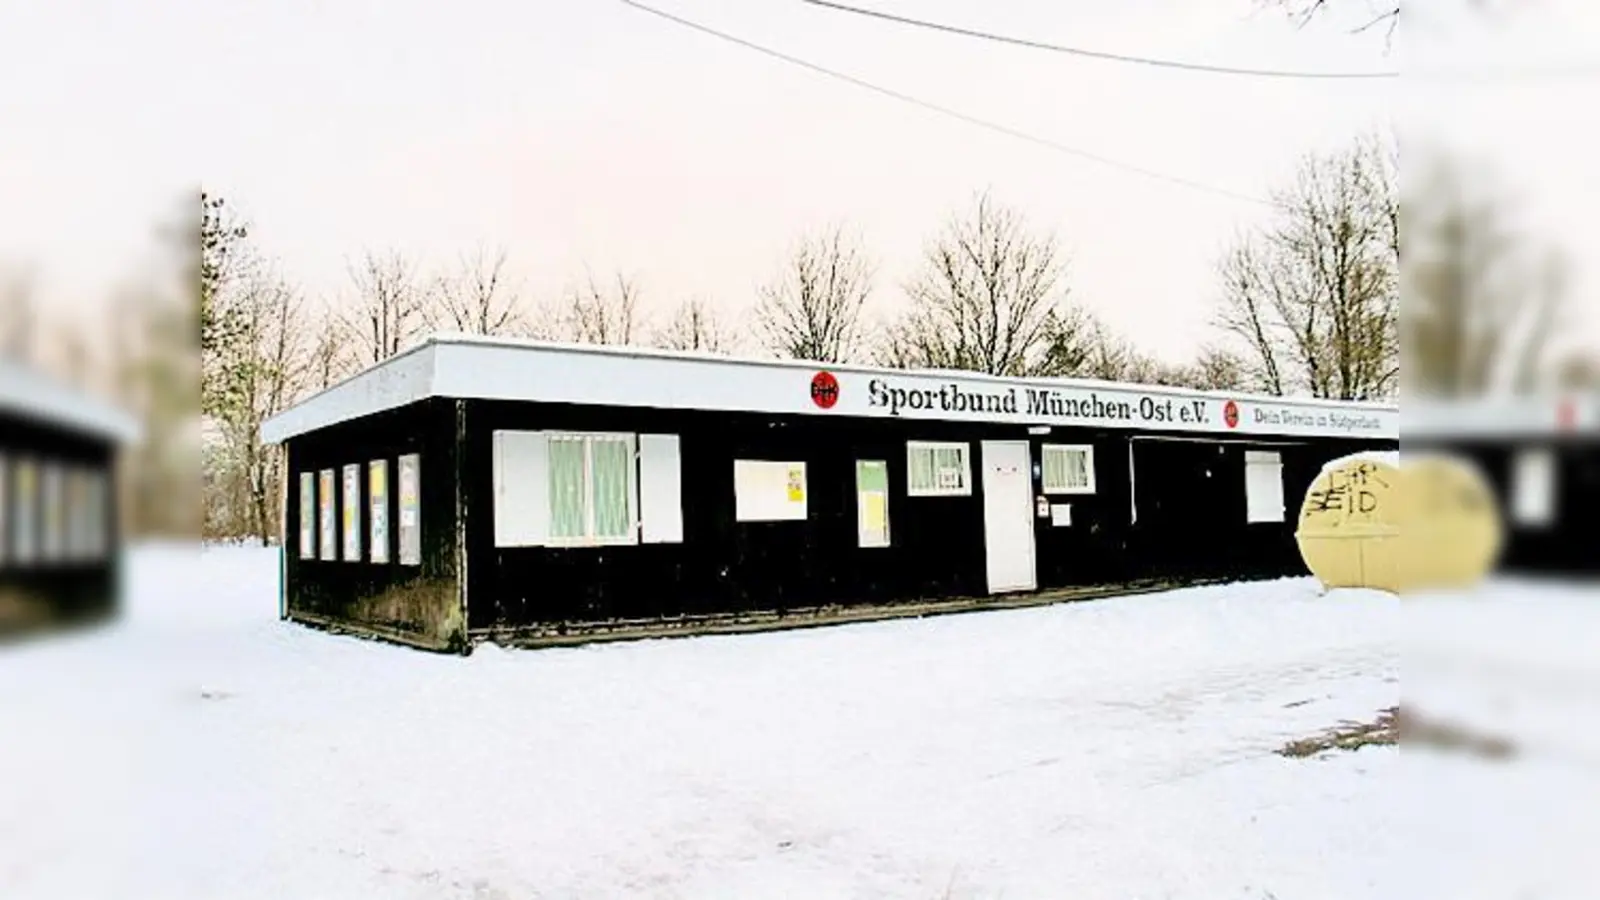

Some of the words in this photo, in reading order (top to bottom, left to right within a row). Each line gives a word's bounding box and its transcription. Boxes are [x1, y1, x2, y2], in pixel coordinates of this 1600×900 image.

[868, 379, 1018, 415] Sportbund
[1025, 389, 1173, 422] München-Ost
[1179, 400, 1210, 424] e.V.
